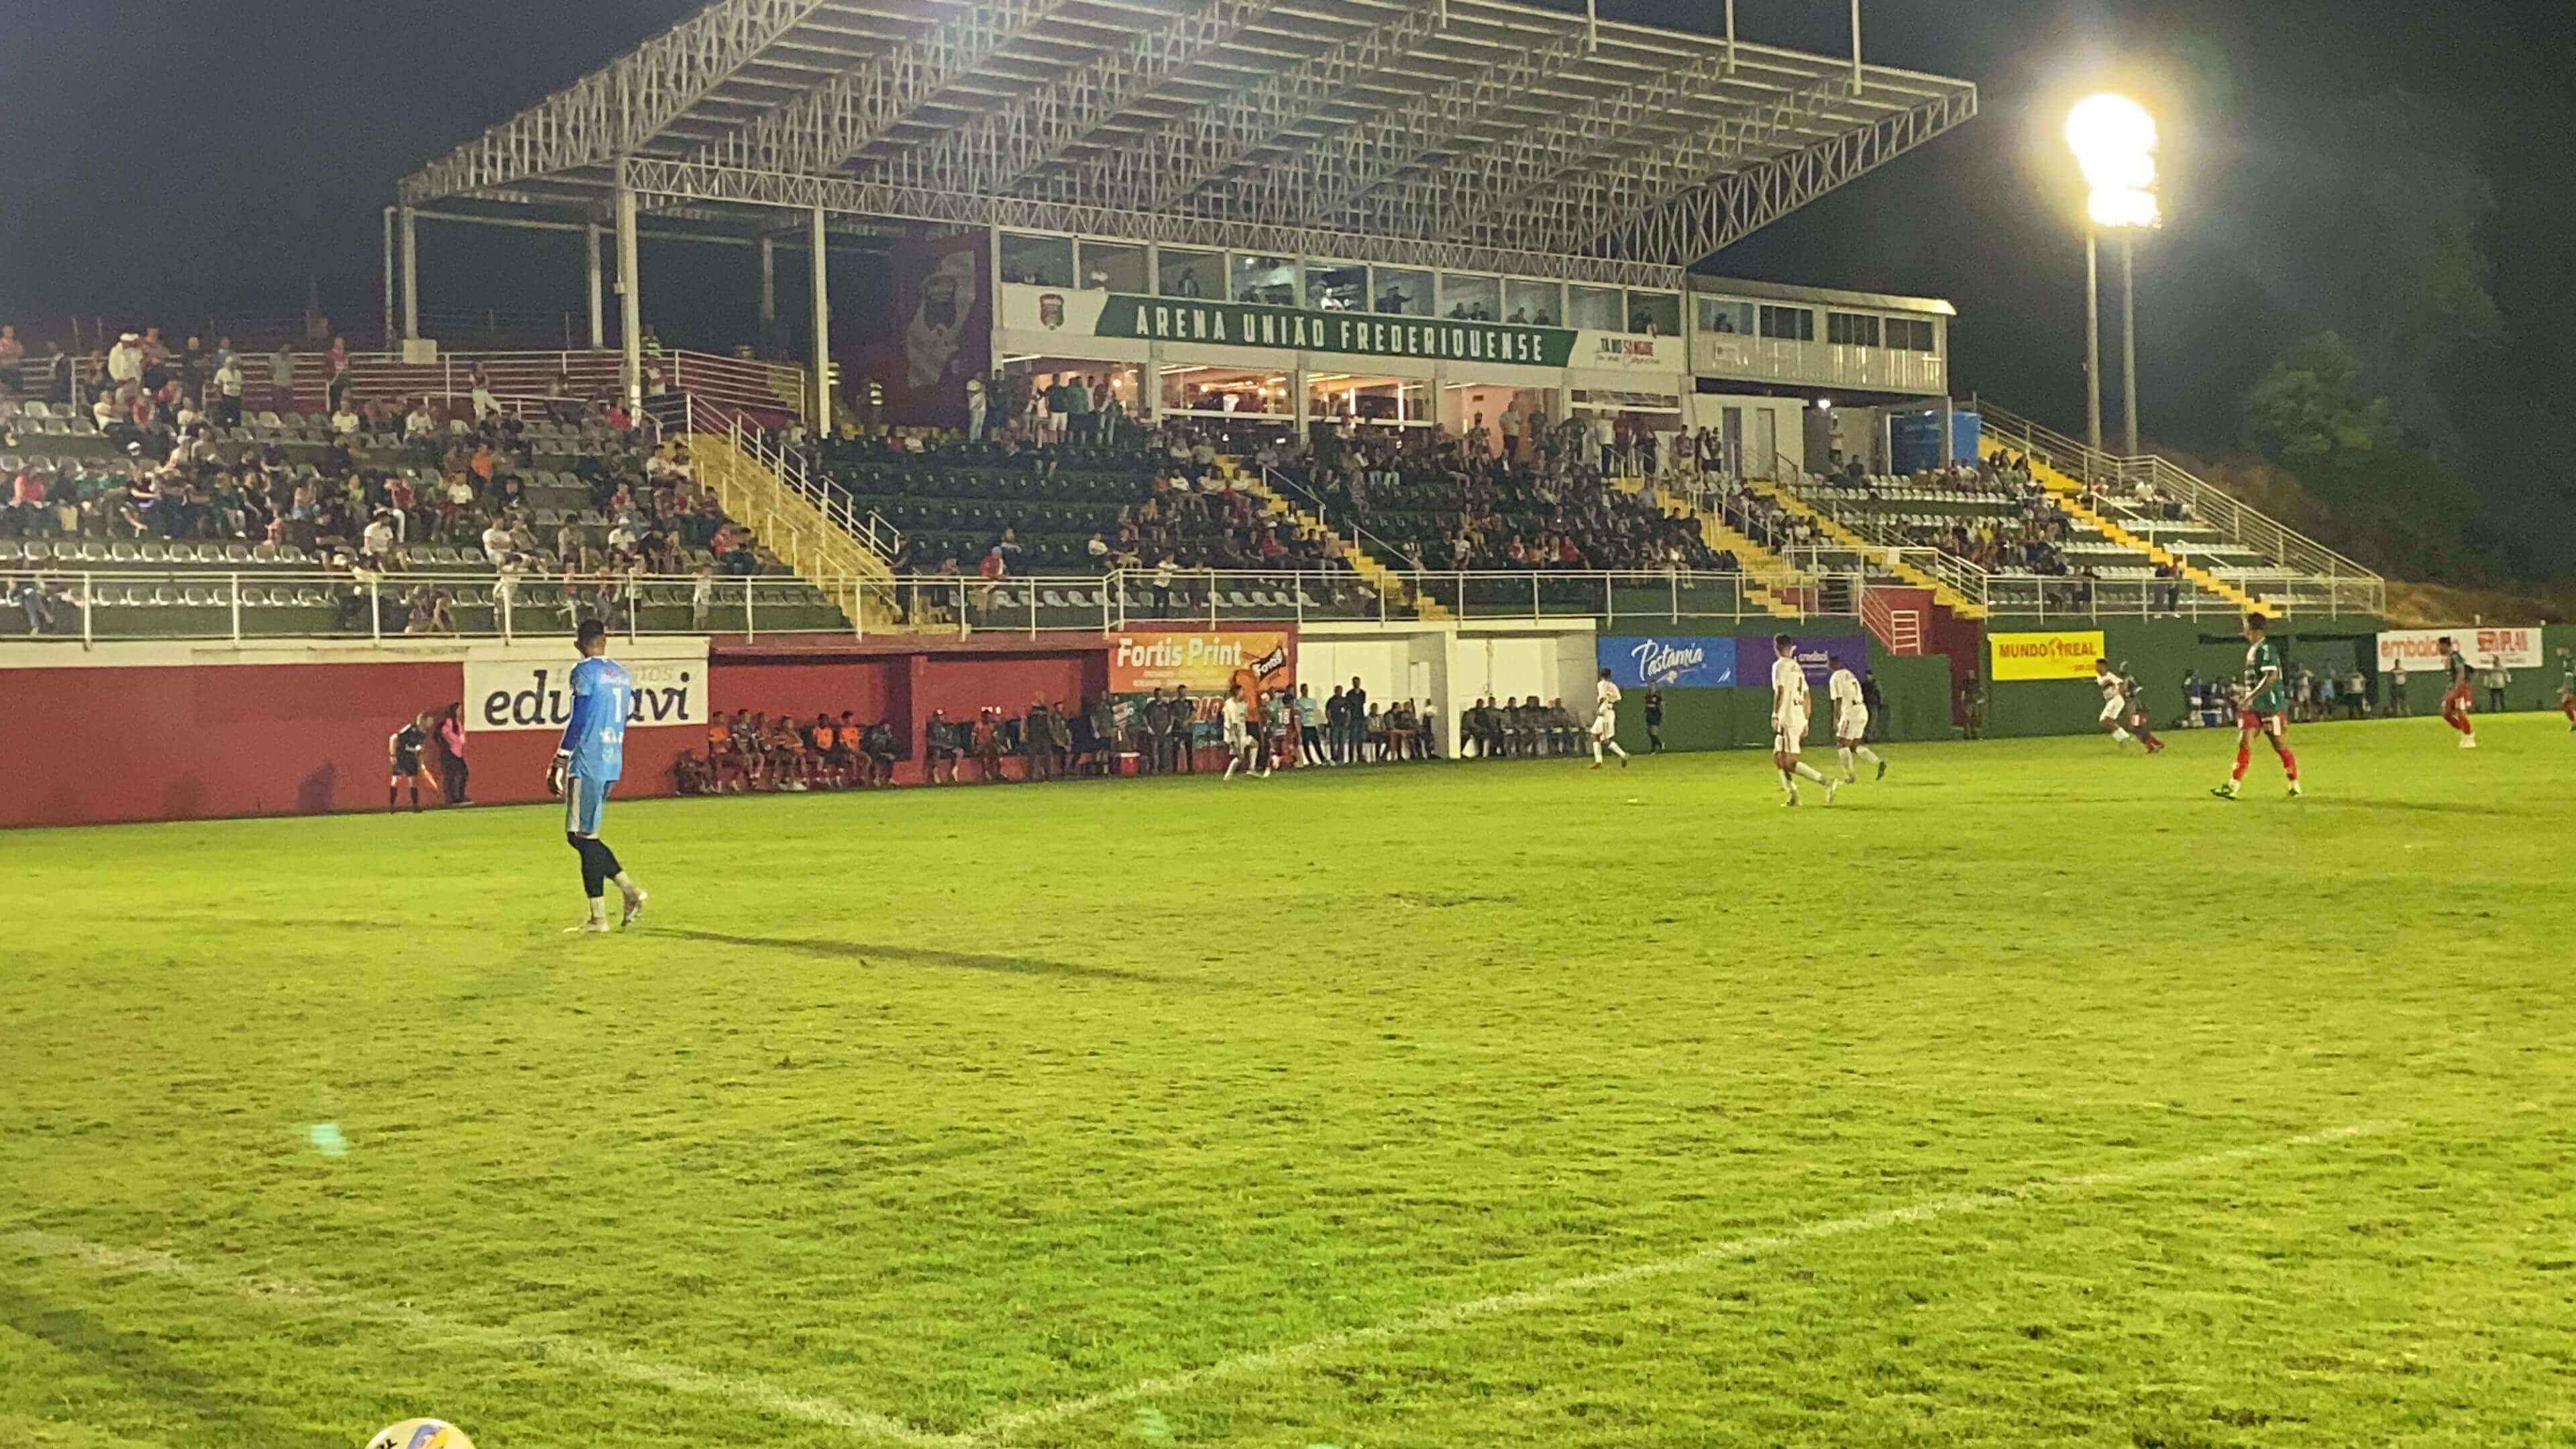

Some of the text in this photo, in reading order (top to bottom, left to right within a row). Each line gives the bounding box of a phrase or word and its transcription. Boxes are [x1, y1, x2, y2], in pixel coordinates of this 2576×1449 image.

[1136, 305, 1543, 362] ARENA UNIÃO FREDERIQUENSE
[1117, 637, 1242, 667] Fortis Print
[1631, 639, 1704, 682] Pastamia
[1999, 641, 2097, 659] MUNDO REAL
[484, 669, 690, 727] eduavi
[612, 687, 623, 723] 1
